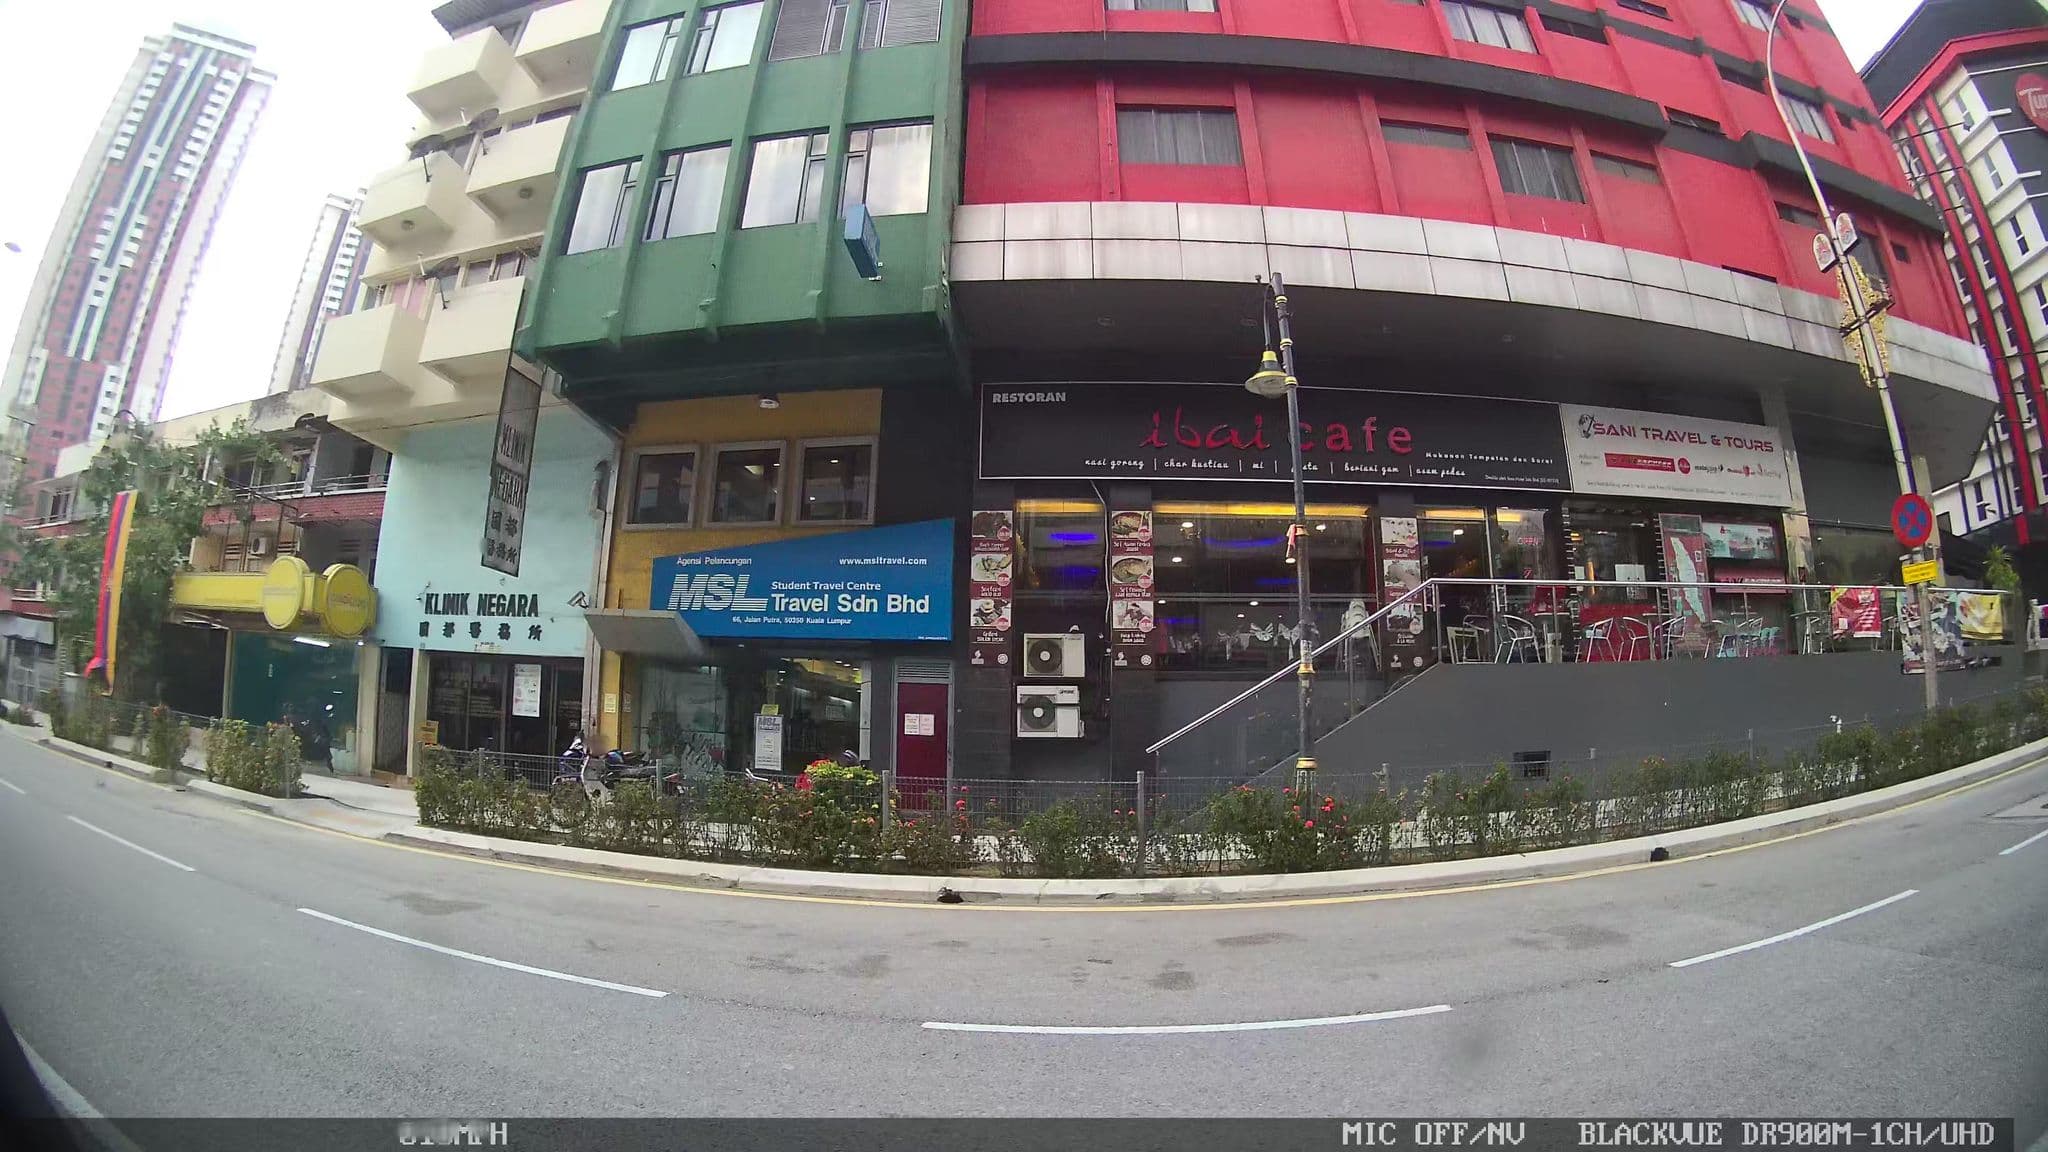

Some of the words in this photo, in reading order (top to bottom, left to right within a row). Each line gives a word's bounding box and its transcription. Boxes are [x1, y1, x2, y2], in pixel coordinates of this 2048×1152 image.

[992, 392, 1066, 403] RESTORAN
[1139, 405, 1271, 450] ibai
[1288, 416, 1414, 454] cafe
[1593, 423, 1637, 438] SANI
[1641, 427, 1707, 445] TRAVEL
[1711, 435, 1721, 444] &
[1724, 436, 1774, 452] TOURS
[500, 424, 526, 465] KLINIK
[1085, 458, 1107, 466] nasi
[1110, 460, 1144, 470] goreng
[1164, 458, 1187, 467] char
[1441, 466, 1466, 478] pedas
[677, 557, 701, 566] Agensi
[705, 557, 752, 566] Pelancungan
[839, 557, 927, 565] www.msltravel.com
[772, 581, 811, 590] Student
[813, 582, 844, 590] Travel
[846, 582, 881, 590] Centre
[667, 574, 769, 611] MSL
[425, 593, 470, 615] KLINIK
[477, 594, 539, 617] NEGARA
[771, 593, 829, 612] Travel
[837, 594, 878, 613] Sdn
[887, 595, 929, 613] Bhd
[827, 618, 852, 626] Lumpur
